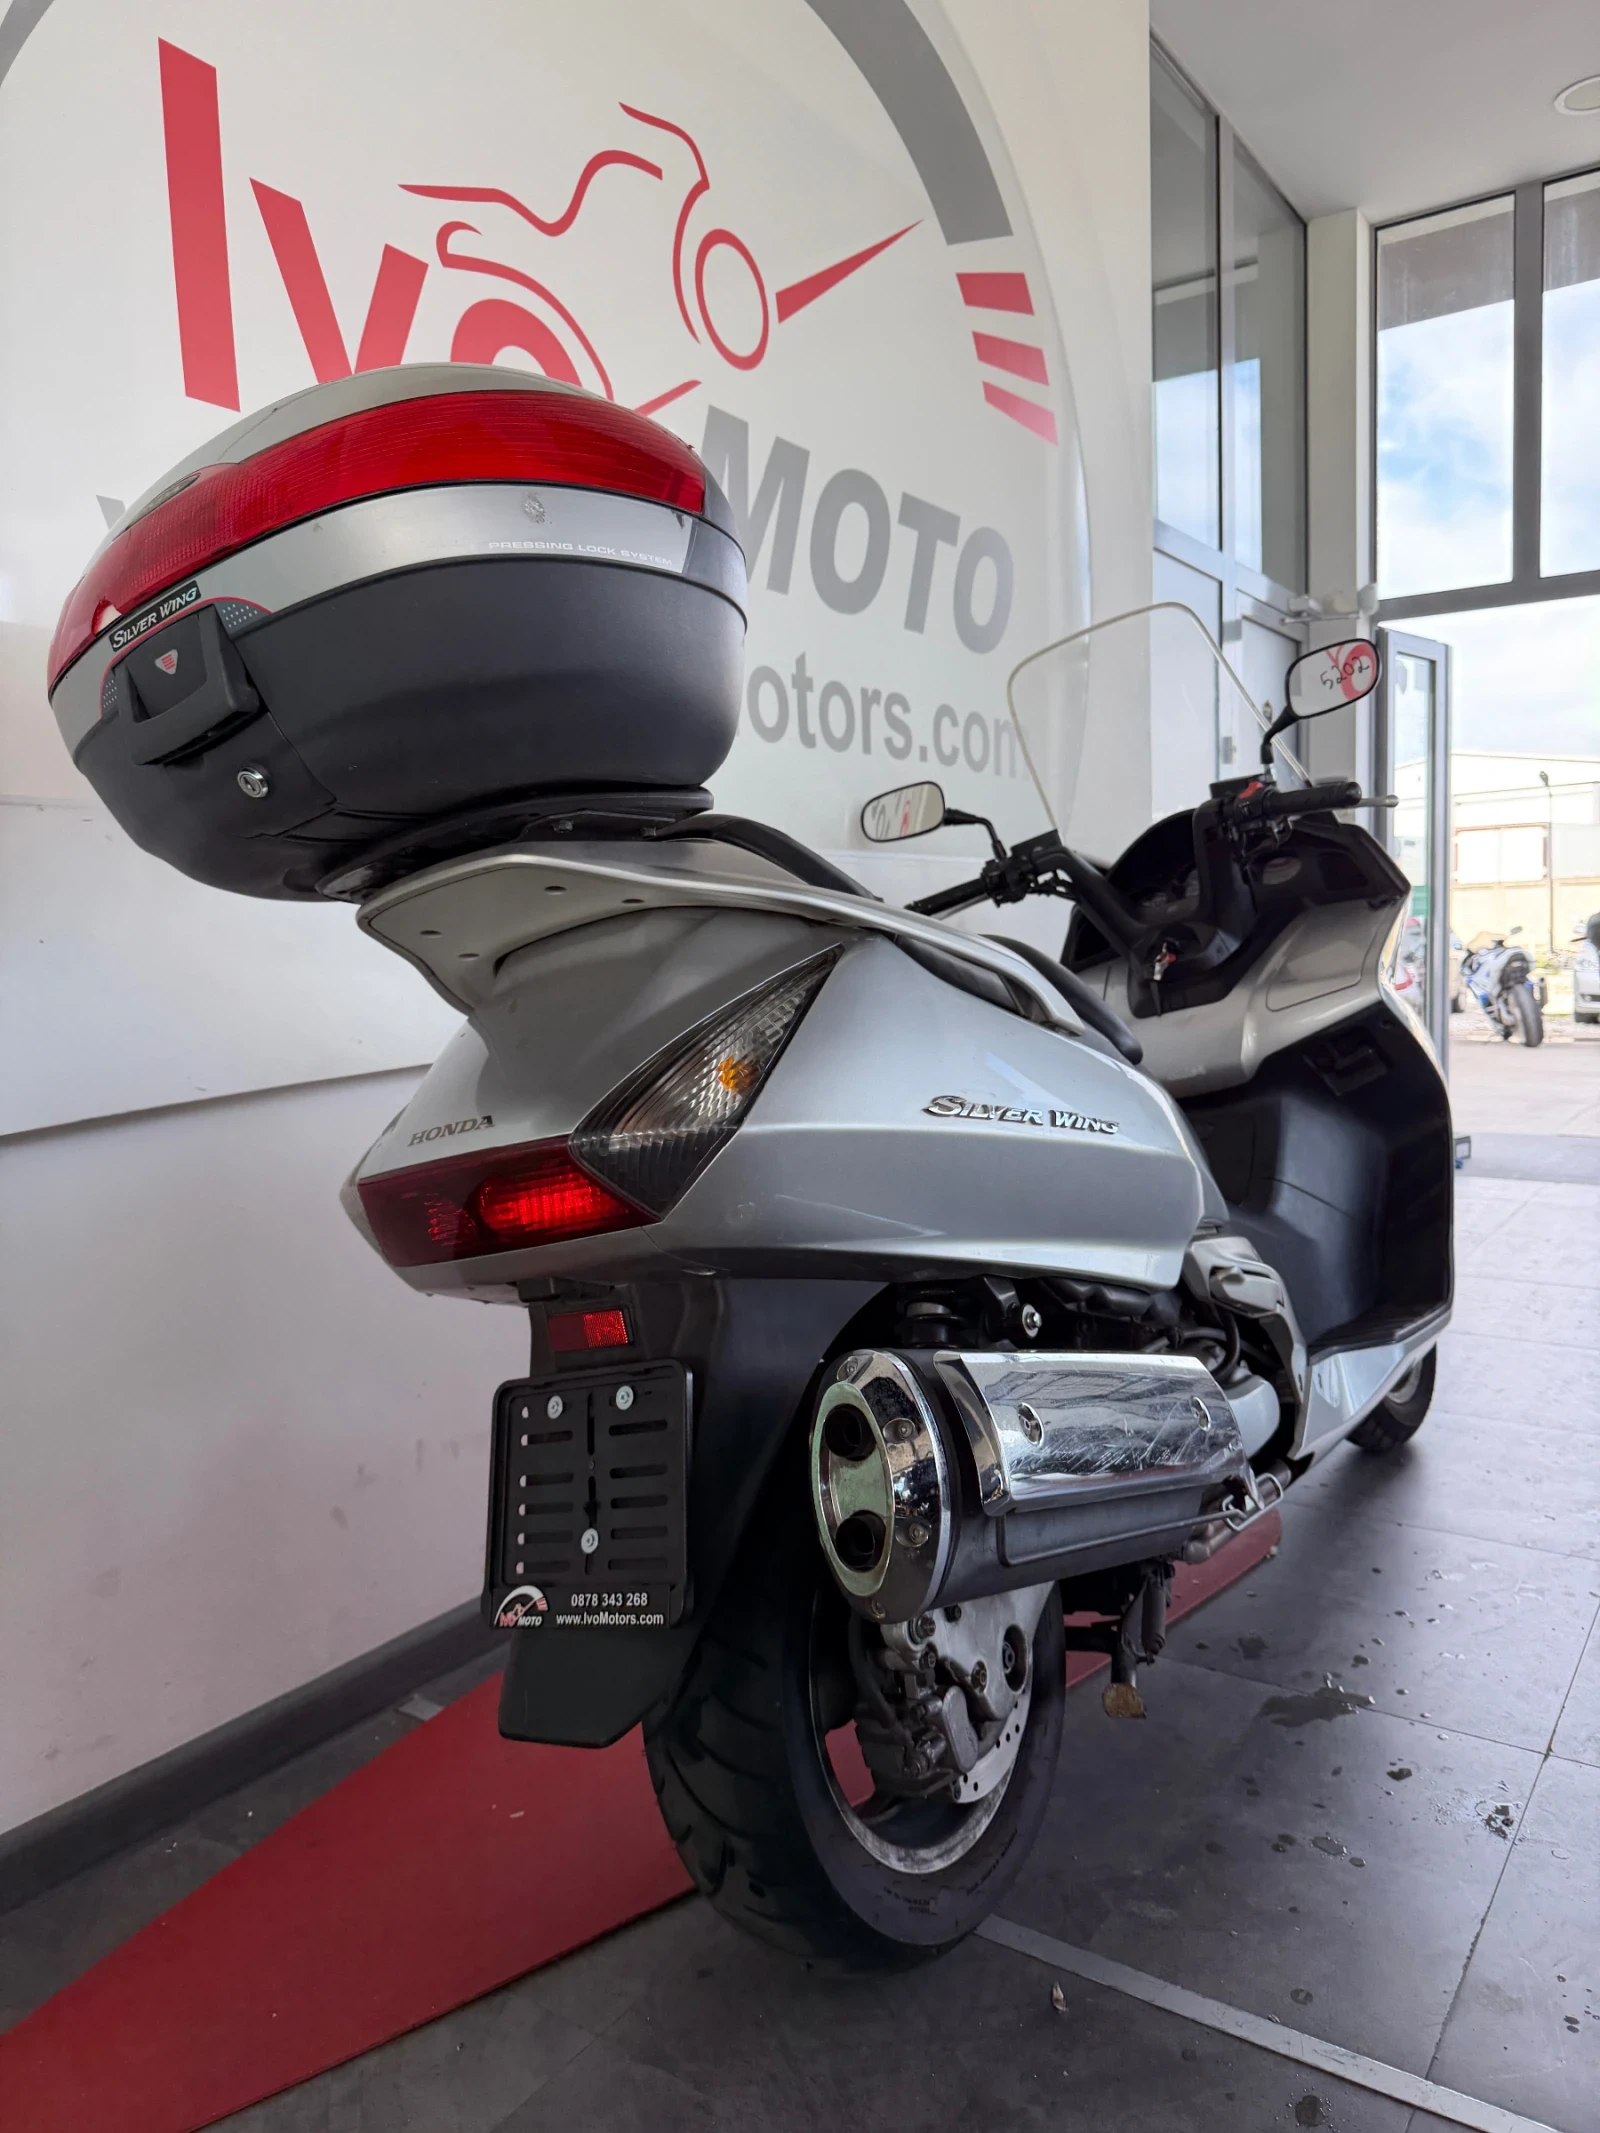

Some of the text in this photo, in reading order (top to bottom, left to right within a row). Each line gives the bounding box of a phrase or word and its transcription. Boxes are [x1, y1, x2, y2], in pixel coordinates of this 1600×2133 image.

[698, 404, 1014, 655] MOTO
[488, 541, 673, 567] PRESSING LOCK SYSTEM
[112, 587, 198, 649] SILVER WING
[922, 1095, 1119, 1135] SILVER WING
[407, 1115, 495, 1147] HONDA
[571, 1592, 648, 1607] 0878 343 268
[517, 1615, 543, 1627] MOTO
[556, 1611, 664, 1626] www.IvoMotors.com
